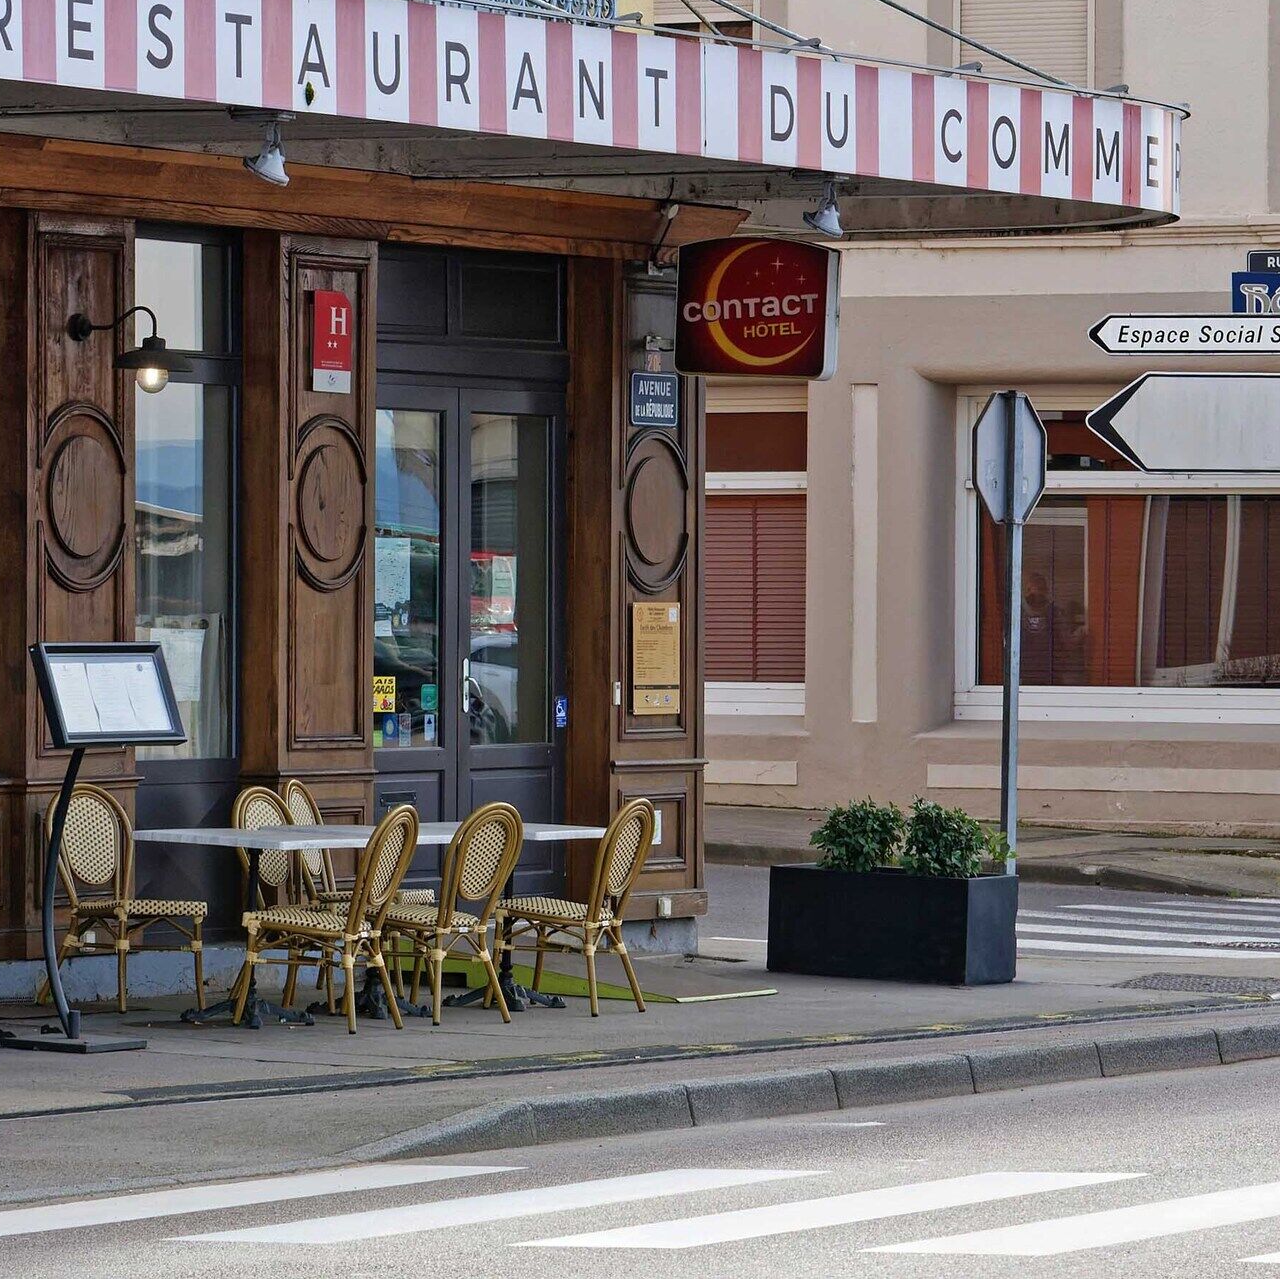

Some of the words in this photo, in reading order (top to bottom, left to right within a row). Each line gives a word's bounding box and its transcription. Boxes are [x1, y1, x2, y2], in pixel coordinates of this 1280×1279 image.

[770, 84, 849, 149] DU
[329, 306, 348, 336] H
[742, 321, 802, 339] HÔTEL
[1117, 324, 1190, 348] Espace
[1198, 324, 1263, 344] Social
[638, 380, 672, 397] AVENUE
[646, 398, 674, 419] RÉPUBLIQUE
